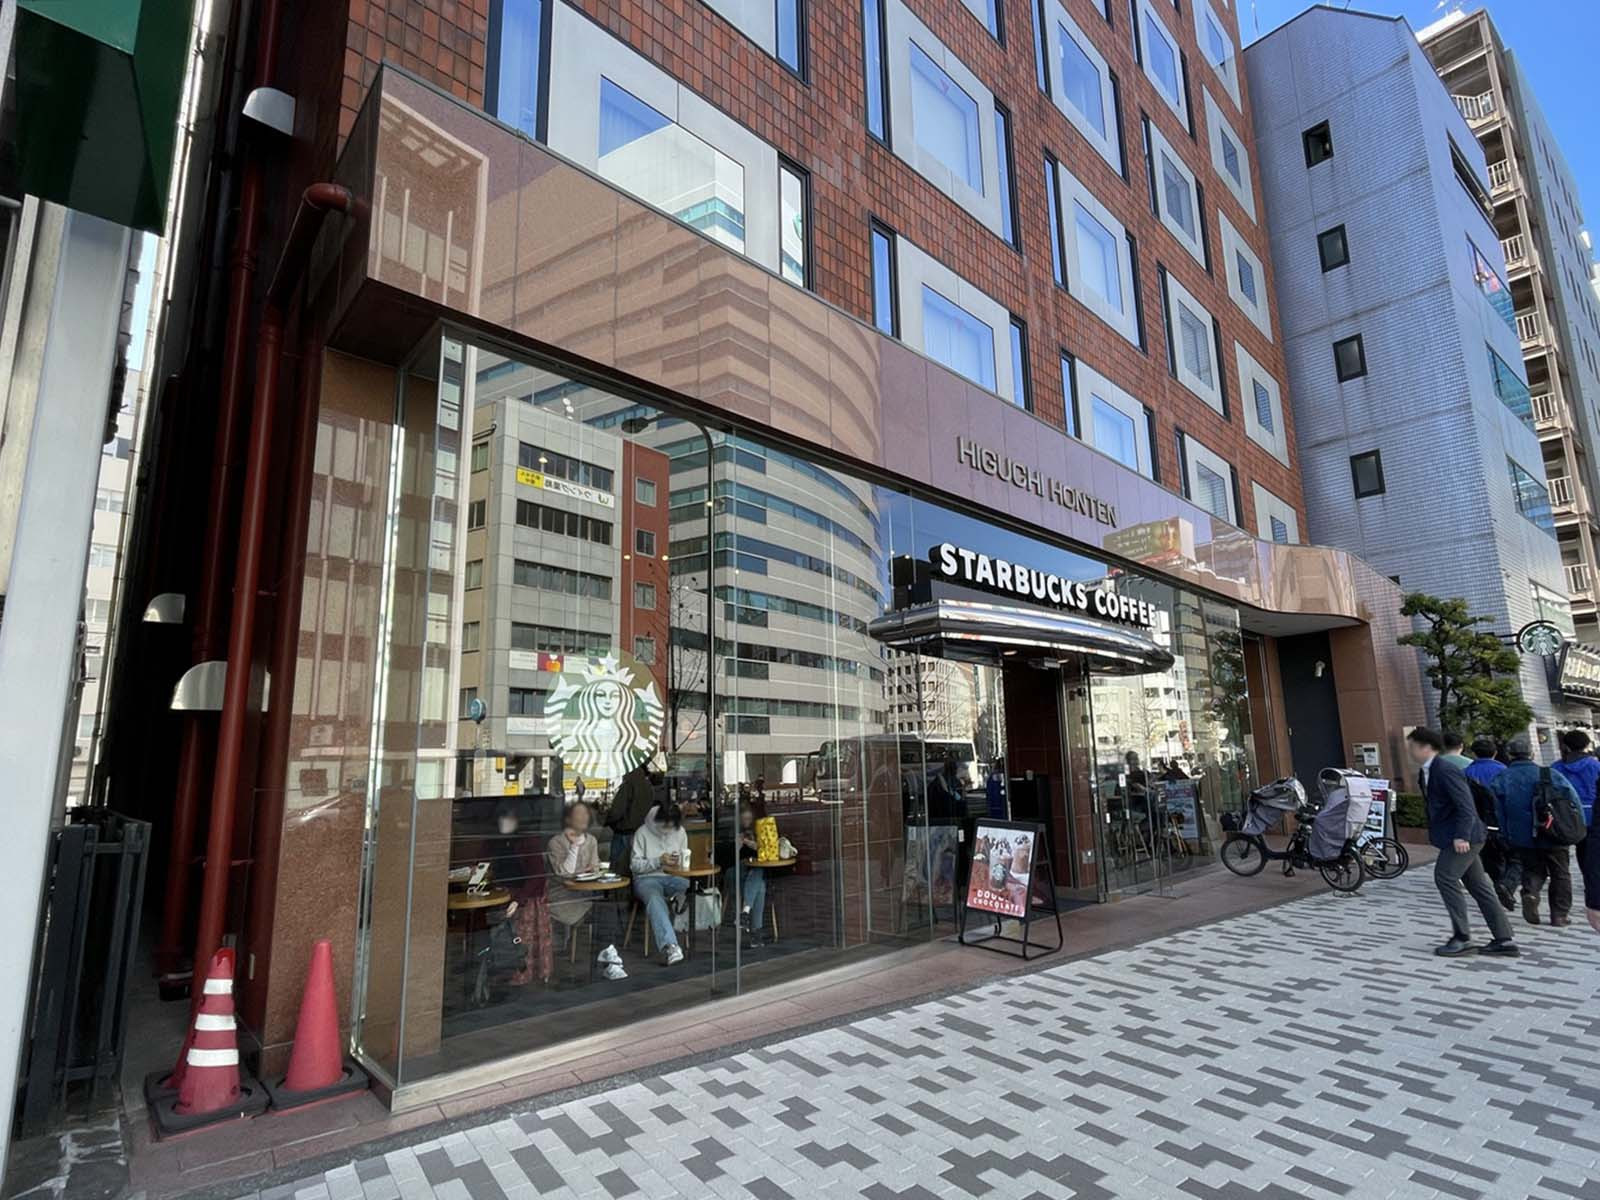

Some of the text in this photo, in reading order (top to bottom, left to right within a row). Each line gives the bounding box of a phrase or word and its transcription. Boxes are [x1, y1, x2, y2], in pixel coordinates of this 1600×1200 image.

[958, 436, 1117, 528] HIGUCHI HONTEN
[939, 542, 1157, 627] STARBUCKS COFFEE
[973, 897, 1019, 911] CHOCOLATE
